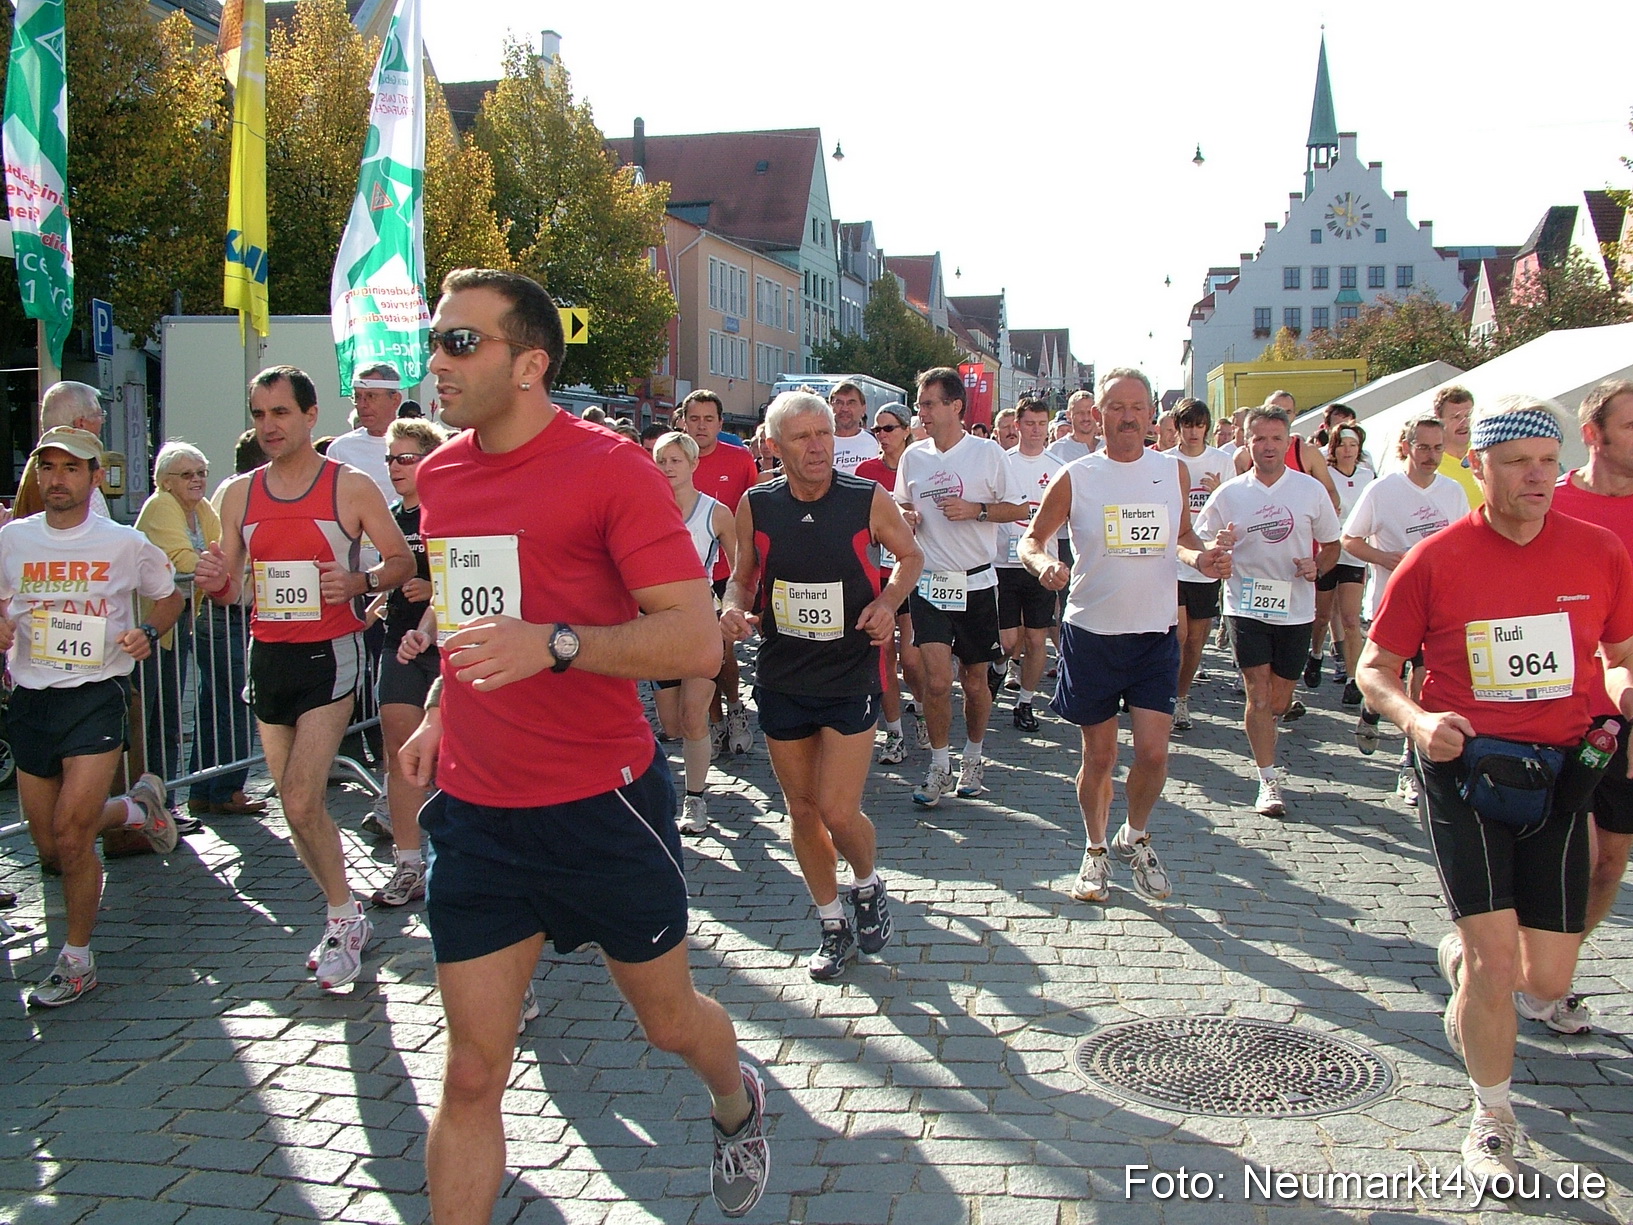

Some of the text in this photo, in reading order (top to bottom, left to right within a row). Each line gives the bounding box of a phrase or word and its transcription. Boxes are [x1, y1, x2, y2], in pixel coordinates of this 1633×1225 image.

[97, 307, 109, 347] P
[115, 386, 124, 402] 3
[130, 388, 142, 491] INDIGO
[1122, 509, 1155, 519] Herbert
[1131, 526, 1160, 541] 527
[450, 548, 480, 568] R-sin
[24, 561, 110, 582] MERZ
[268, 567, 290, 579] Klaus
[932, 573, 949, 583] Peter
[20, 575, 89, 594] Reisen
[1254, 581, 1273, 591] Franz
[275, 587, 308, 605] 509
[461, 586, 505, 616] 803
[789, 587, 828, 600] Gerhard
[932, 587, 963, 600] 2875
[1253, 596, 1286, 610] 2874
[52, 617, 82, 632] Roland
[798, 608, 832, 625] 593
[1494, 625, 1523, 643] Rudi
[56, 639, 92, 658] 416
[1508, 650, 1558, 678] 964
